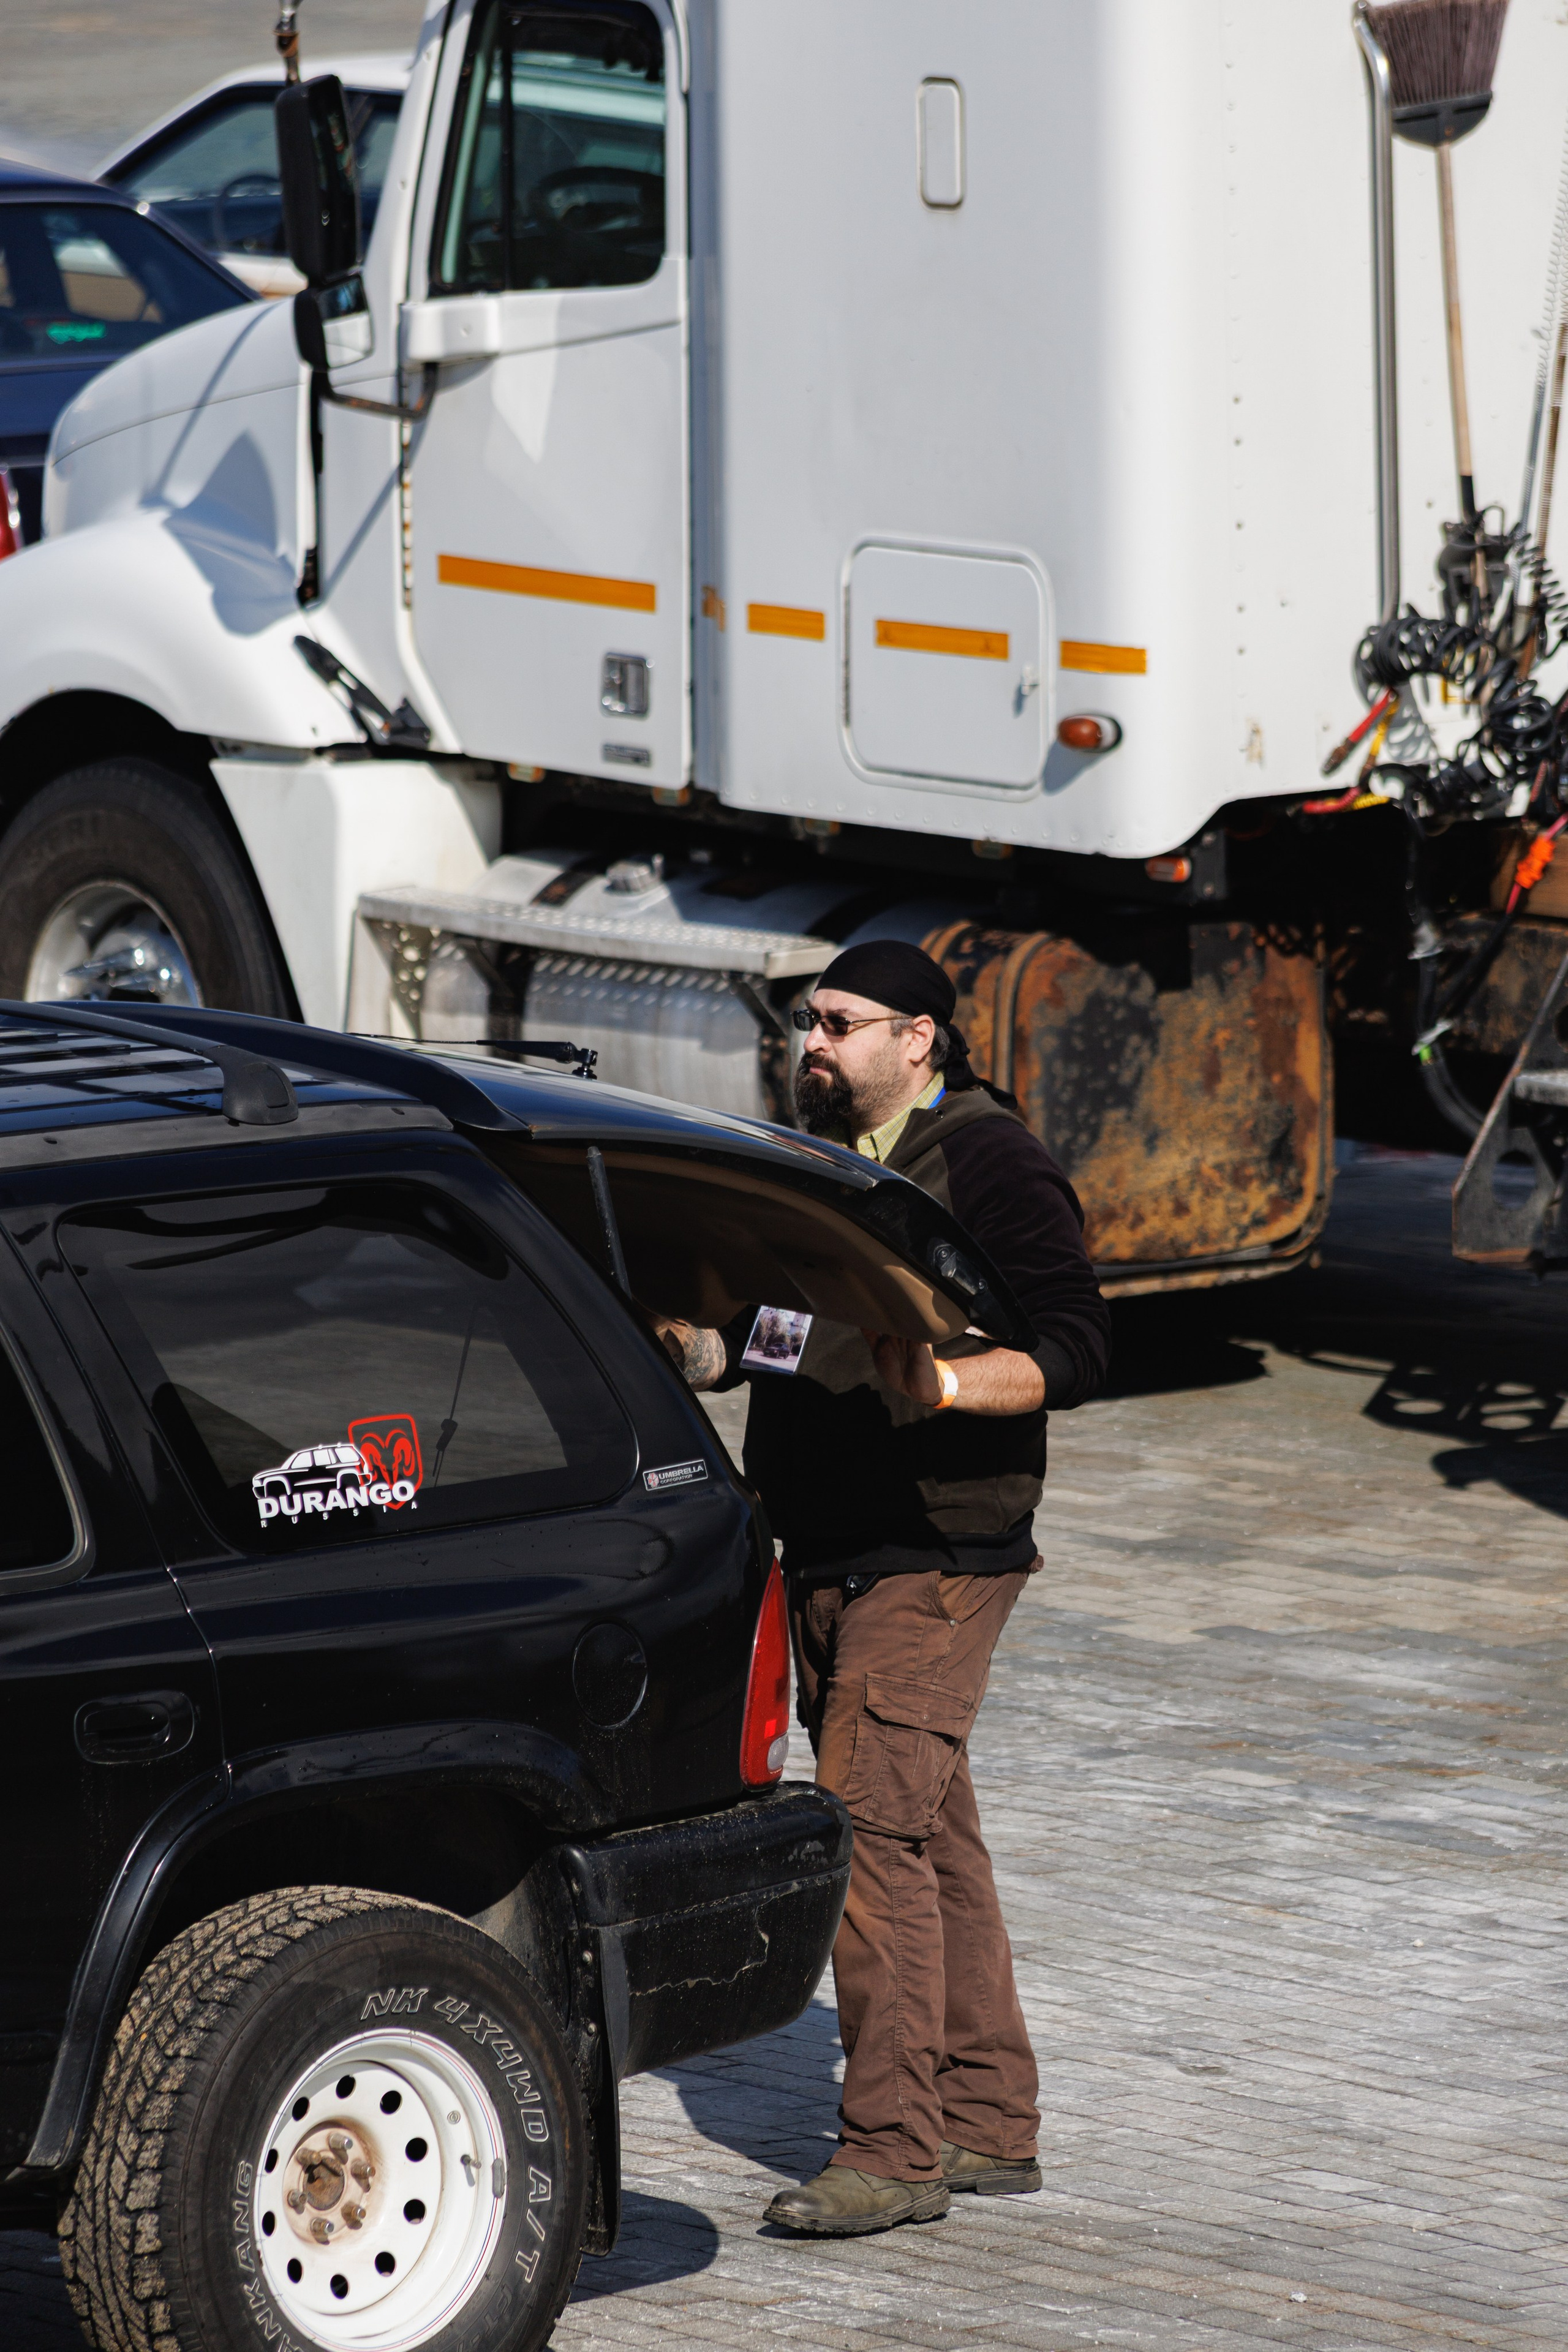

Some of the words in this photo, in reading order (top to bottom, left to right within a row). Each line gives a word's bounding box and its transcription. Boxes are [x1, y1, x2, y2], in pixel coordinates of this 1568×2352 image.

[658, 1465, 704, 1479] UMBRELLA
[660, 1474, 693, 1484] CORPORATION
[258, 1480, 415, 1519] DURANGO
[261, 1502, 417, 1528] RUSSIA
[361, 1988, 429, 2020] NK
[434, 1995, 549, 2143] 4X4WD
[514, 2166, 552, 2284] A/T
